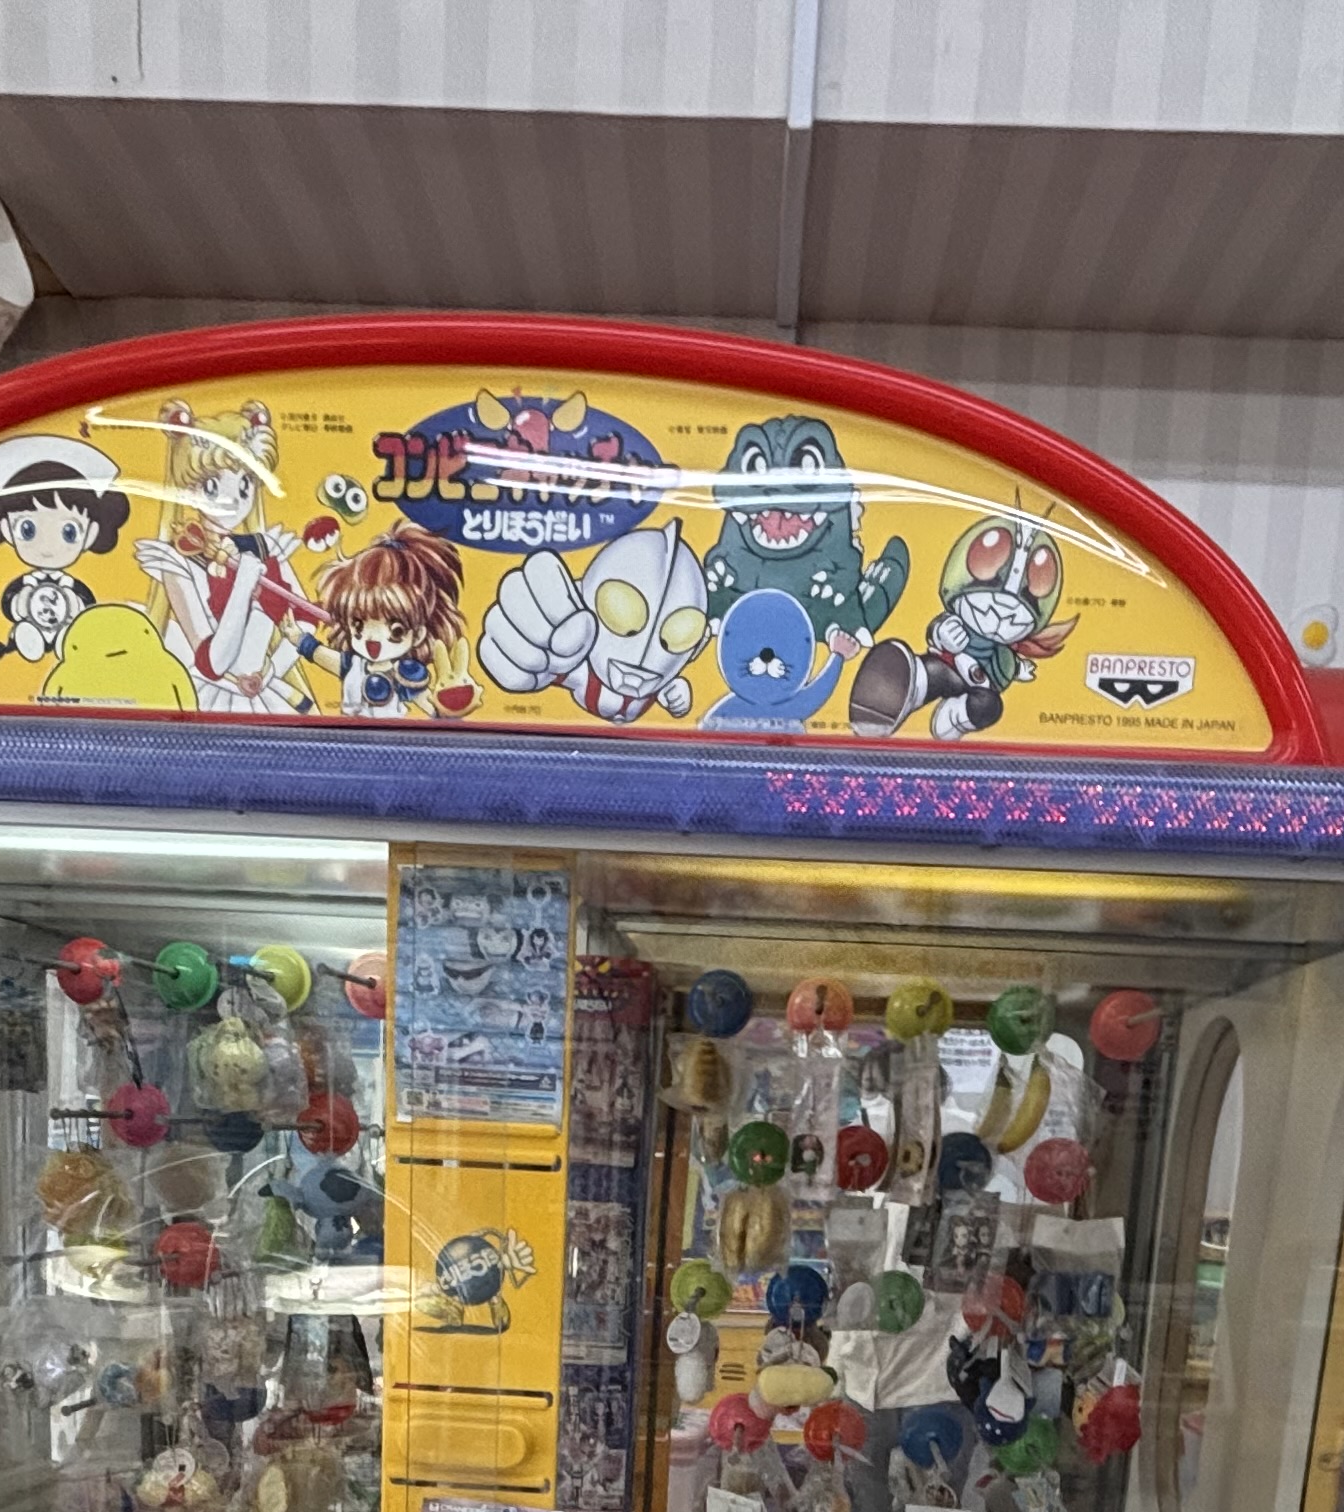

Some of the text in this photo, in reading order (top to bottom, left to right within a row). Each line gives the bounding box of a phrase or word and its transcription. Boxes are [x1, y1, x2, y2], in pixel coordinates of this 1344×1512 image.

[461, 508, 590, 544] とりほうだい
[1089, 656, 1192, 679] BANPRESTO
[1039, 711, 1113, 728] BANPRESTO
[1144, 717, 1178, 729] MADE
[1181, 718, 1194, 730] IN
[1197, 719, 1236, 732] JAPAN
